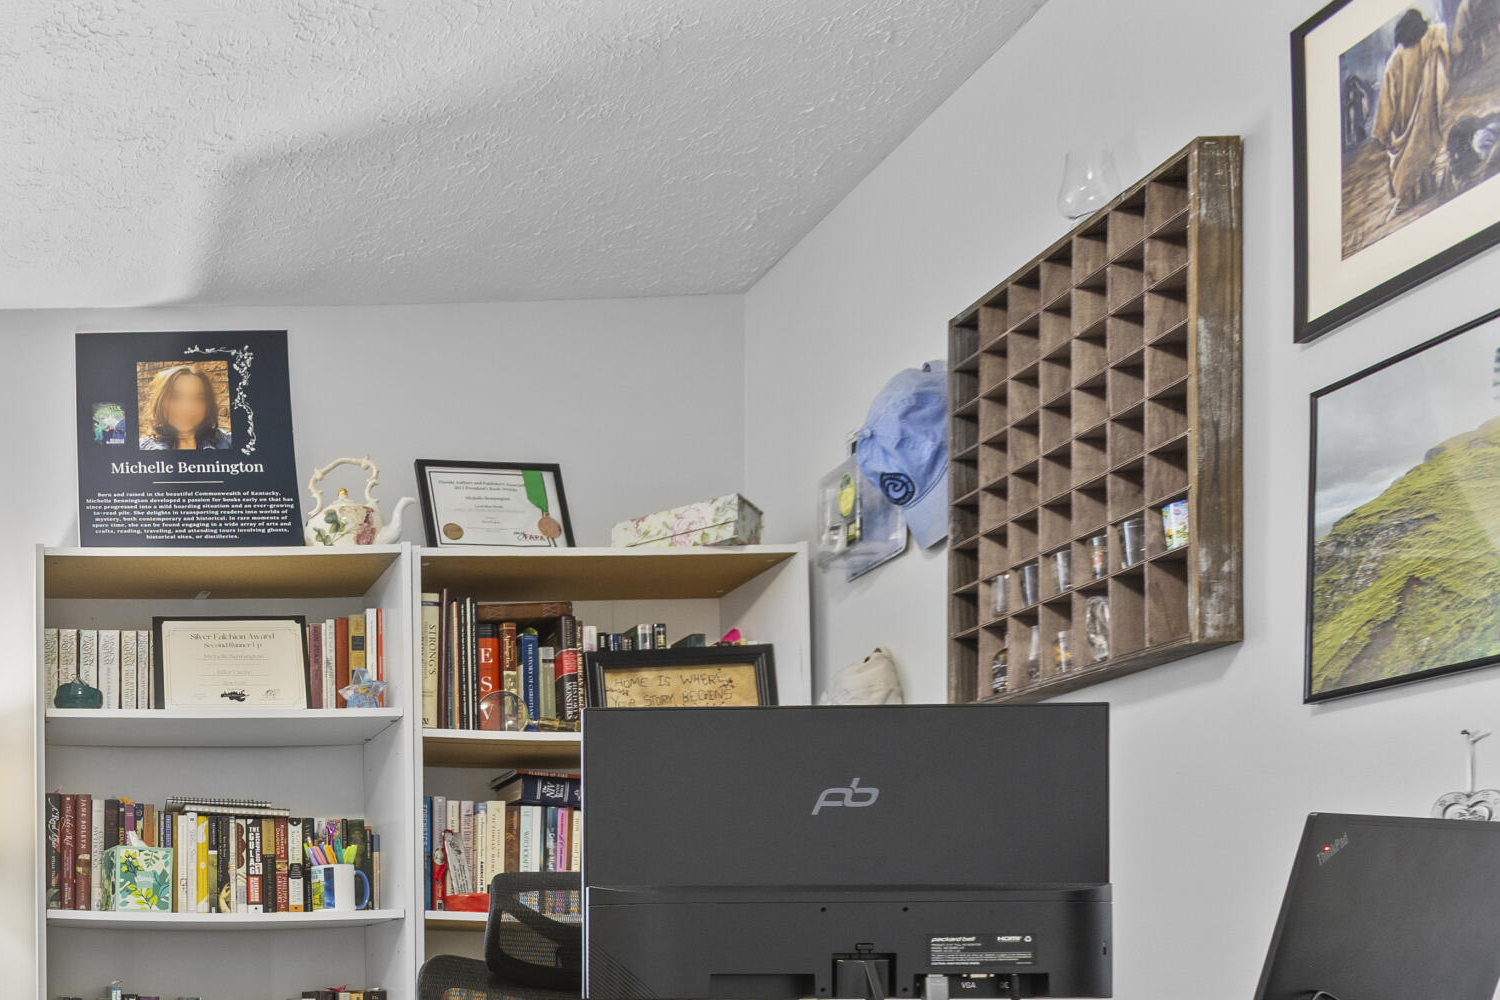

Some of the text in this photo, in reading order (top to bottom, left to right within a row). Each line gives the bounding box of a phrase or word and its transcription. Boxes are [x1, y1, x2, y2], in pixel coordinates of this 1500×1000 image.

[111, 461, 264, 475] Michelle Bennington
[189, 632, 213, 640] Silver
[248, 632, 275, 640] Award
[577, 642, 583, 651] AN
[529, 676, 534, 684] OF
[614, 672, 725, 688] HOME IS WHERE
[644, 694, 675, 706] STORY
[683, 688, 733, 703] BEGINS
[546, 781, 556, 798] NIV
